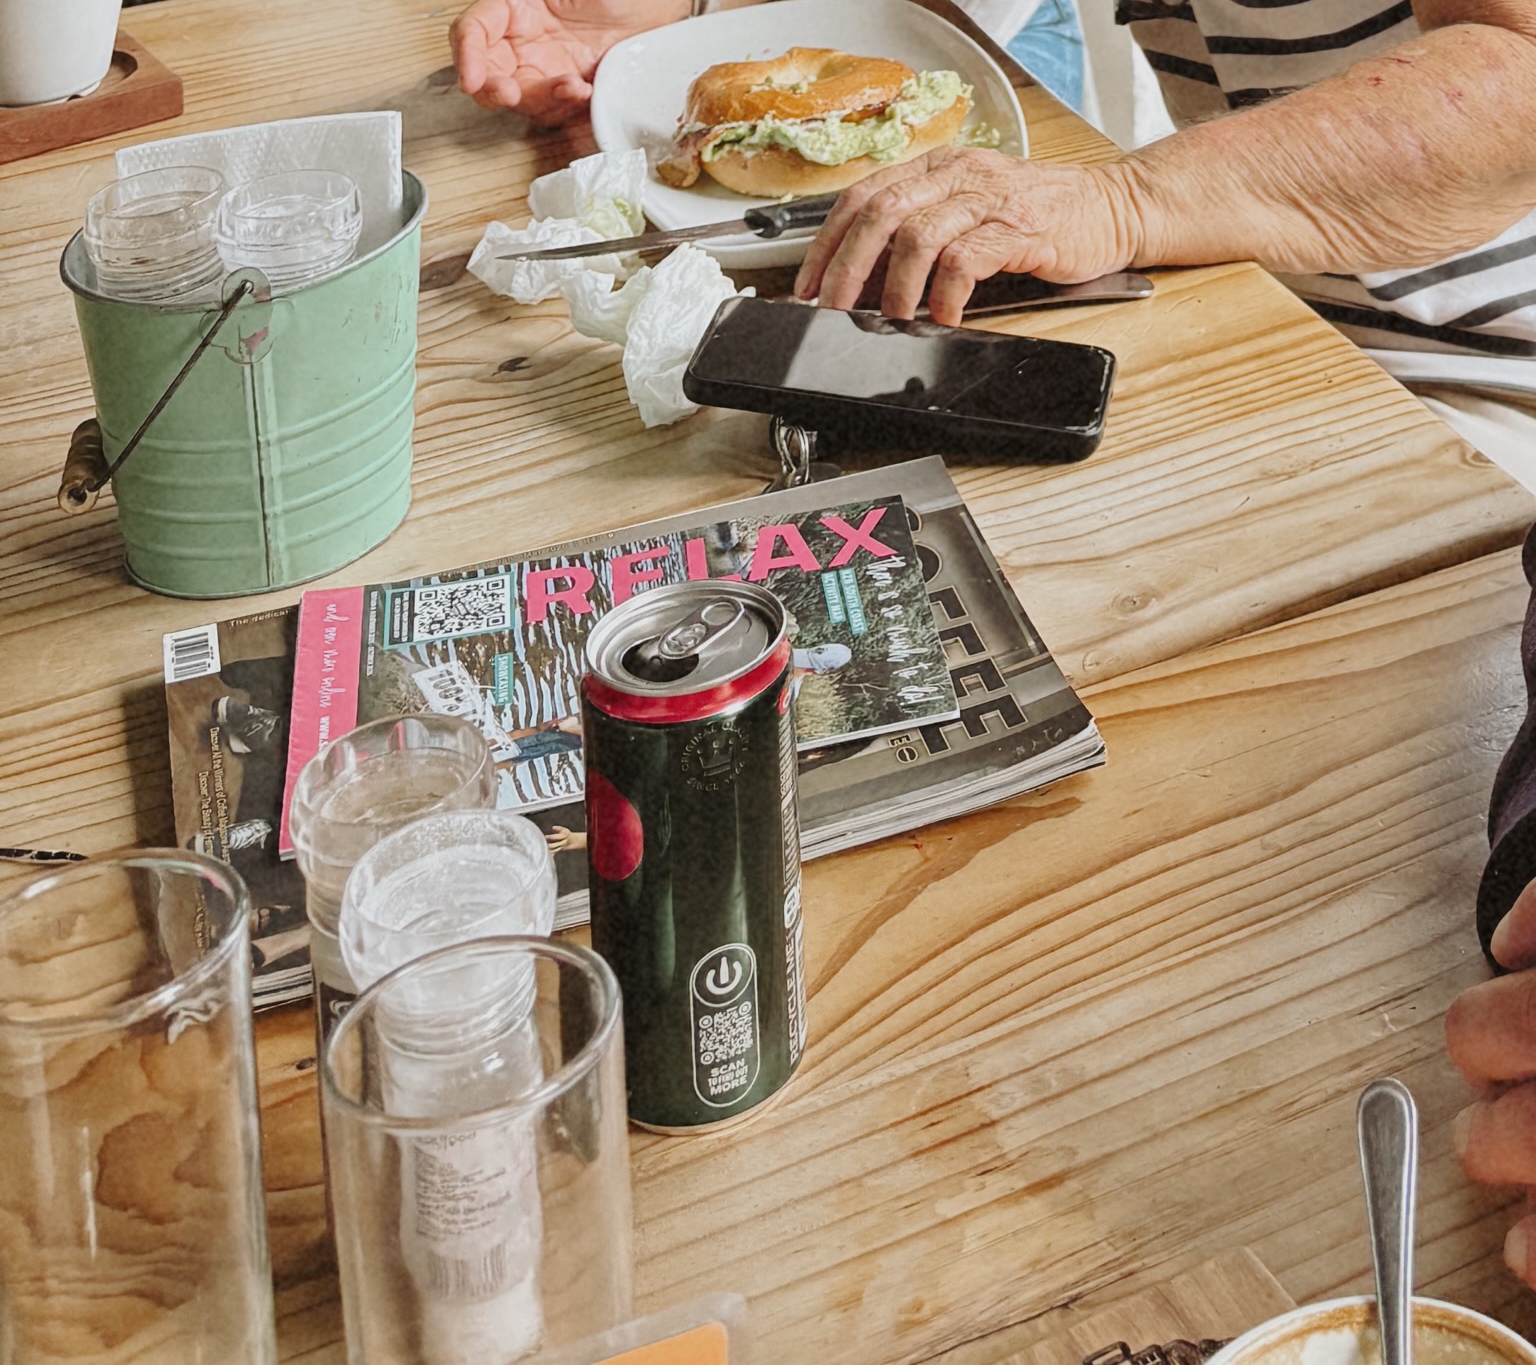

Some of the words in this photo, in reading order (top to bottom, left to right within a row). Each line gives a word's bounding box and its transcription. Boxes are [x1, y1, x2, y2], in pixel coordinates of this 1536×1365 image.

[524, 507, 897, 623] RELAX
[785, 940, 796, 971] ME
[786, 975, 800, 1066] RECYCLE
[711, 1057, 745, 1078] SCAN
[710, 1076, 748, 1096] MORE
